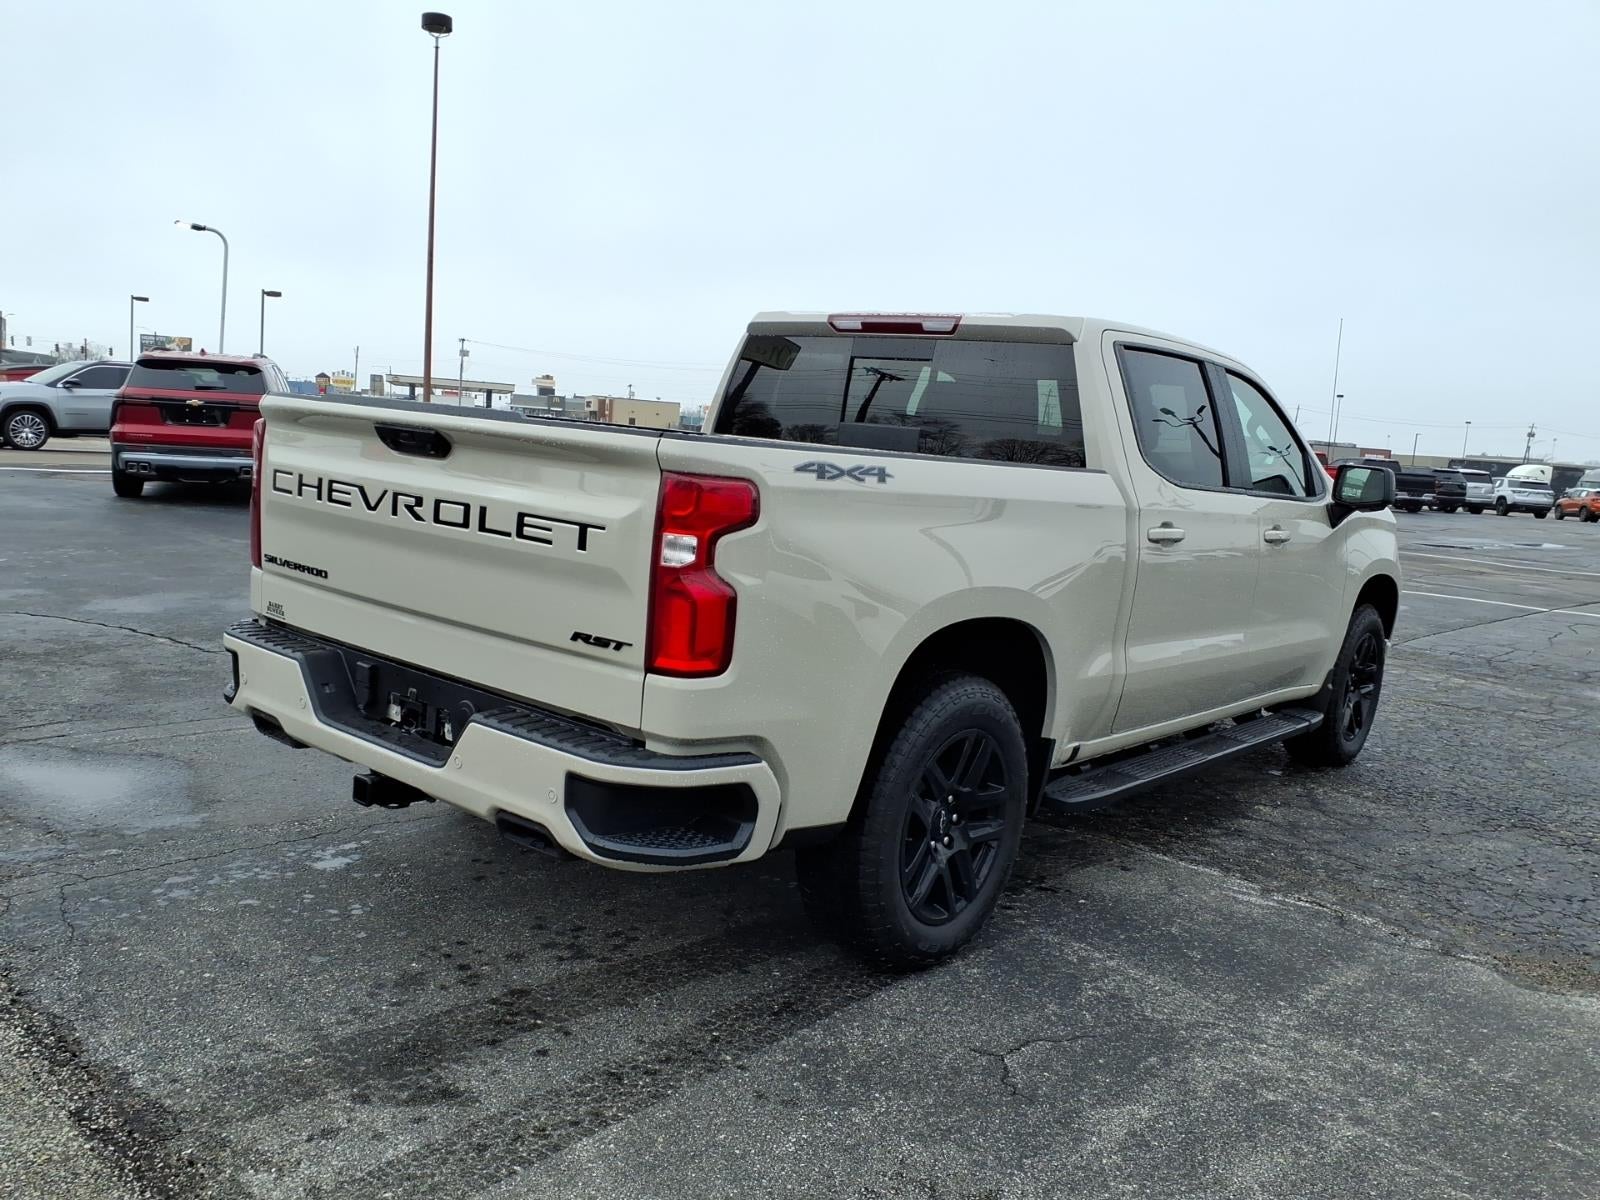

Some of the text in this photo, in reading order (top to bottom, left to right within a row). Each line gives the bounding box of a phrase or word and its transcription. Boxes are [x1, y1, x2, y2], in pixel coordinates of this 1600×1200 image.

[272, 469, 606, 552] CHEVROLET
[264, 553, 328, 579] SILVERADO
[570, 631, 633, 652] RST
